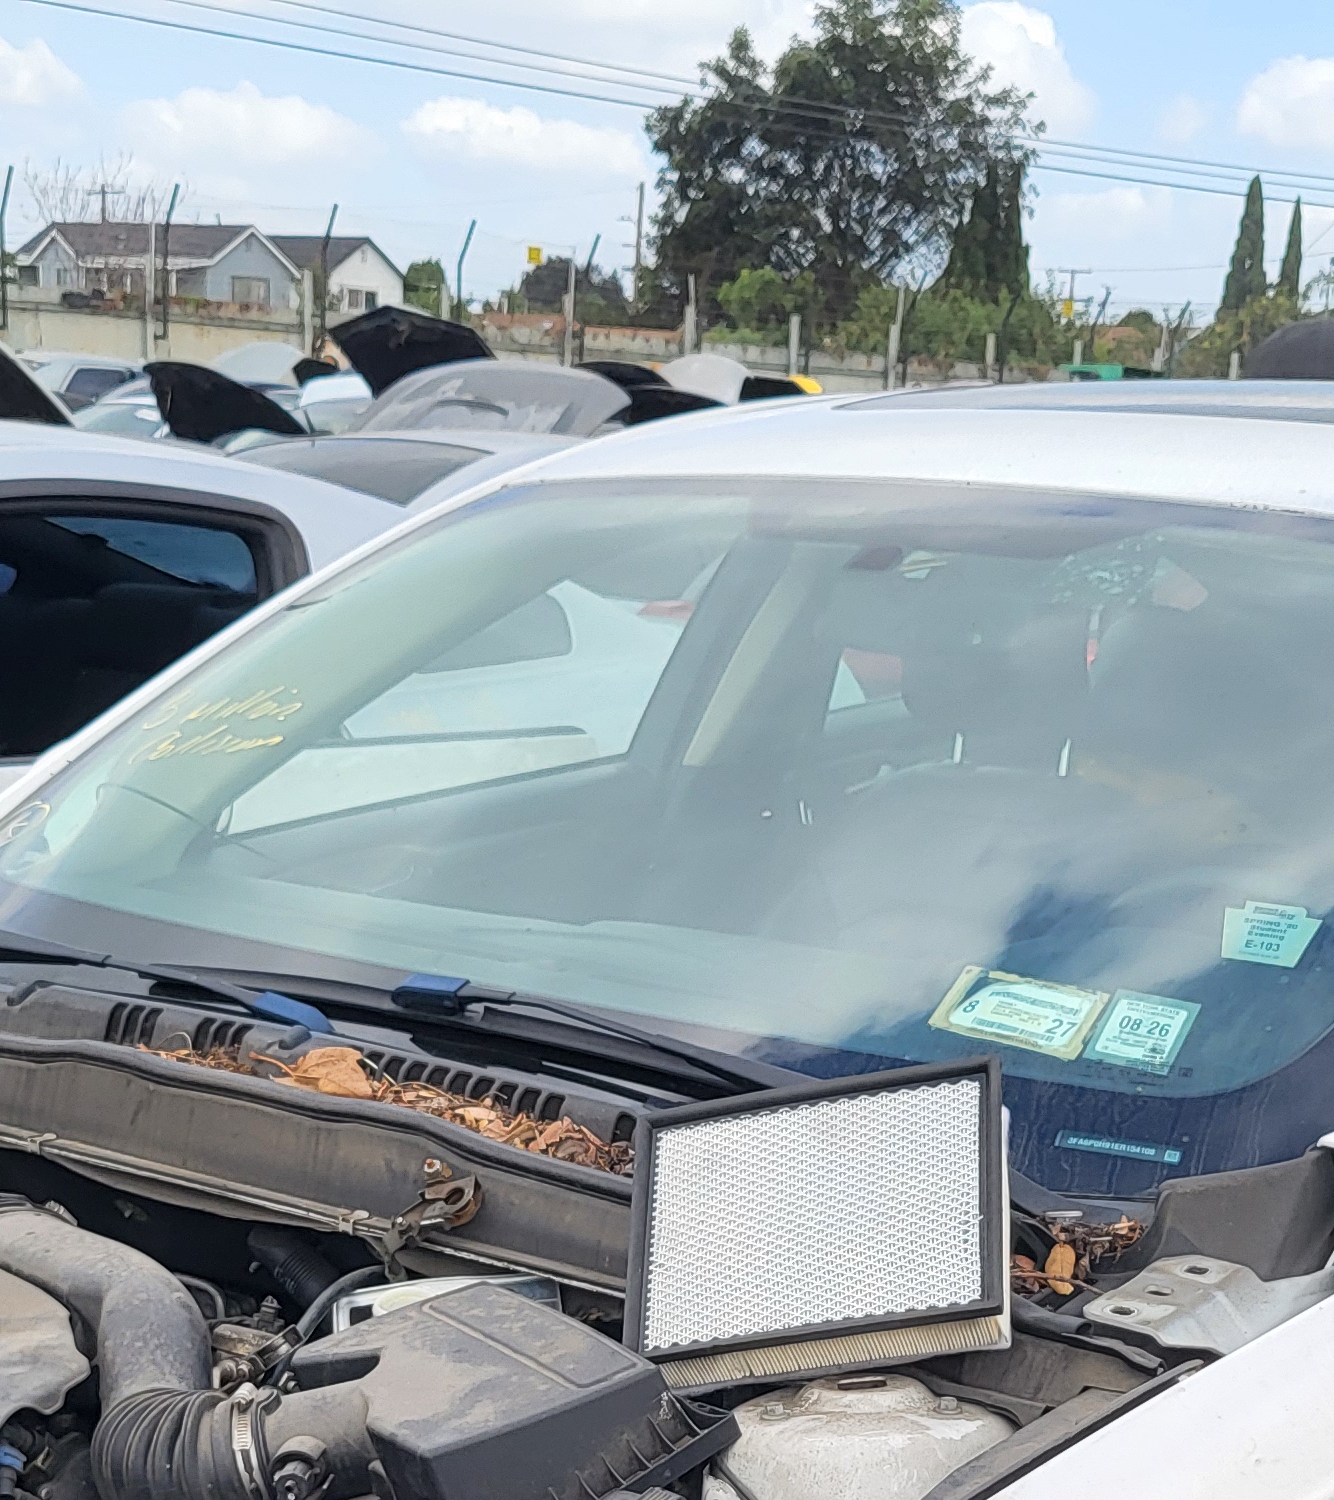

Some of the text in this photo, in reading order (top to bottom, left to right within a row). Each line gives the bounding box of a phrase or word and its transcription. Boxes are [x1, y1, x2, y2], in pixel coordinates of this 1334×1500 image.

[1244, 939, 1281, 952] E-103
[962, 1000, 980, 1014] 8
[1044, 1018, 1079, 1038] 27
[1118, 1015, 1144, 1032] 08
[1146, 1020, 1172, 1037] 26
